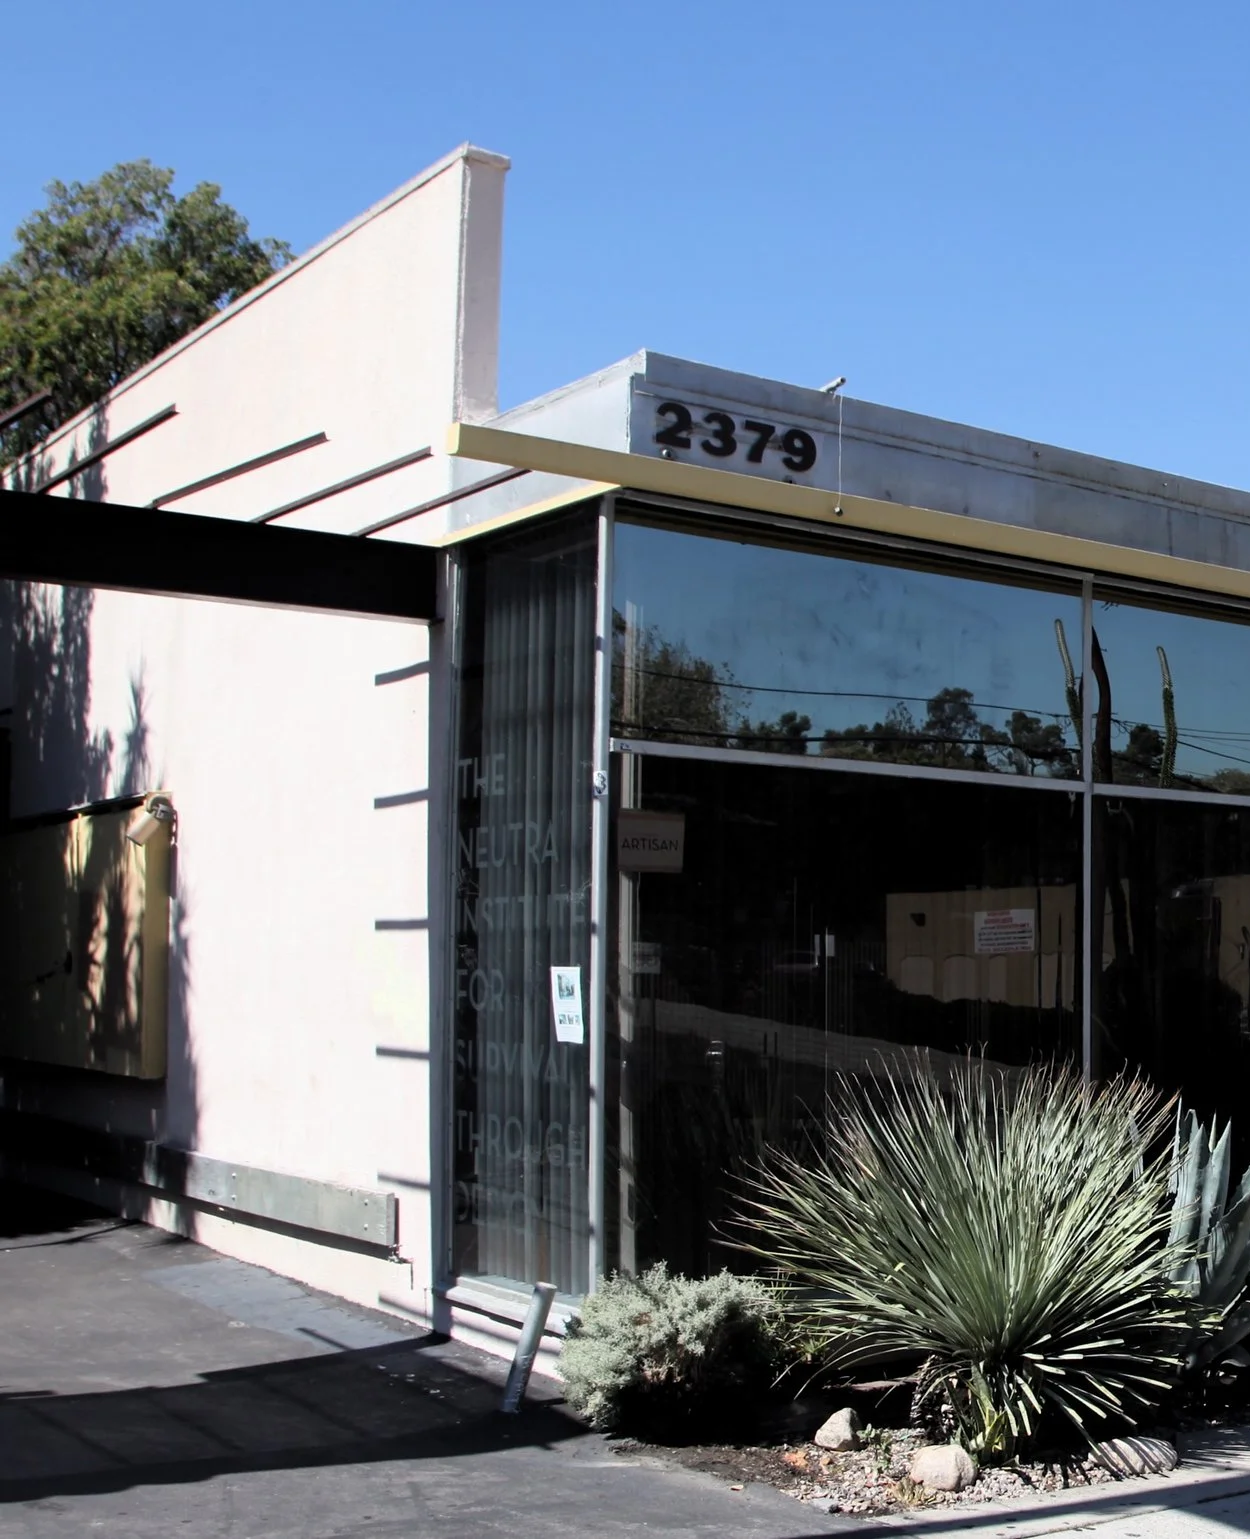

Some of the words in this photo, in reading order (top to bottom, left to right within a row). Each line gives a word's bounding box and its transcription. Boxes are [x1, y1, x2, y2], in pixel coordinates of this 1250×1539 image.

[655, 402, 817, 473] 2379
[457, 753, 506, 798] THE
[457, 820, 559, 869] NEUTRA
[621, 837, 679, 851] ARTISAN
[456, 968, 505, 1012] FOR
